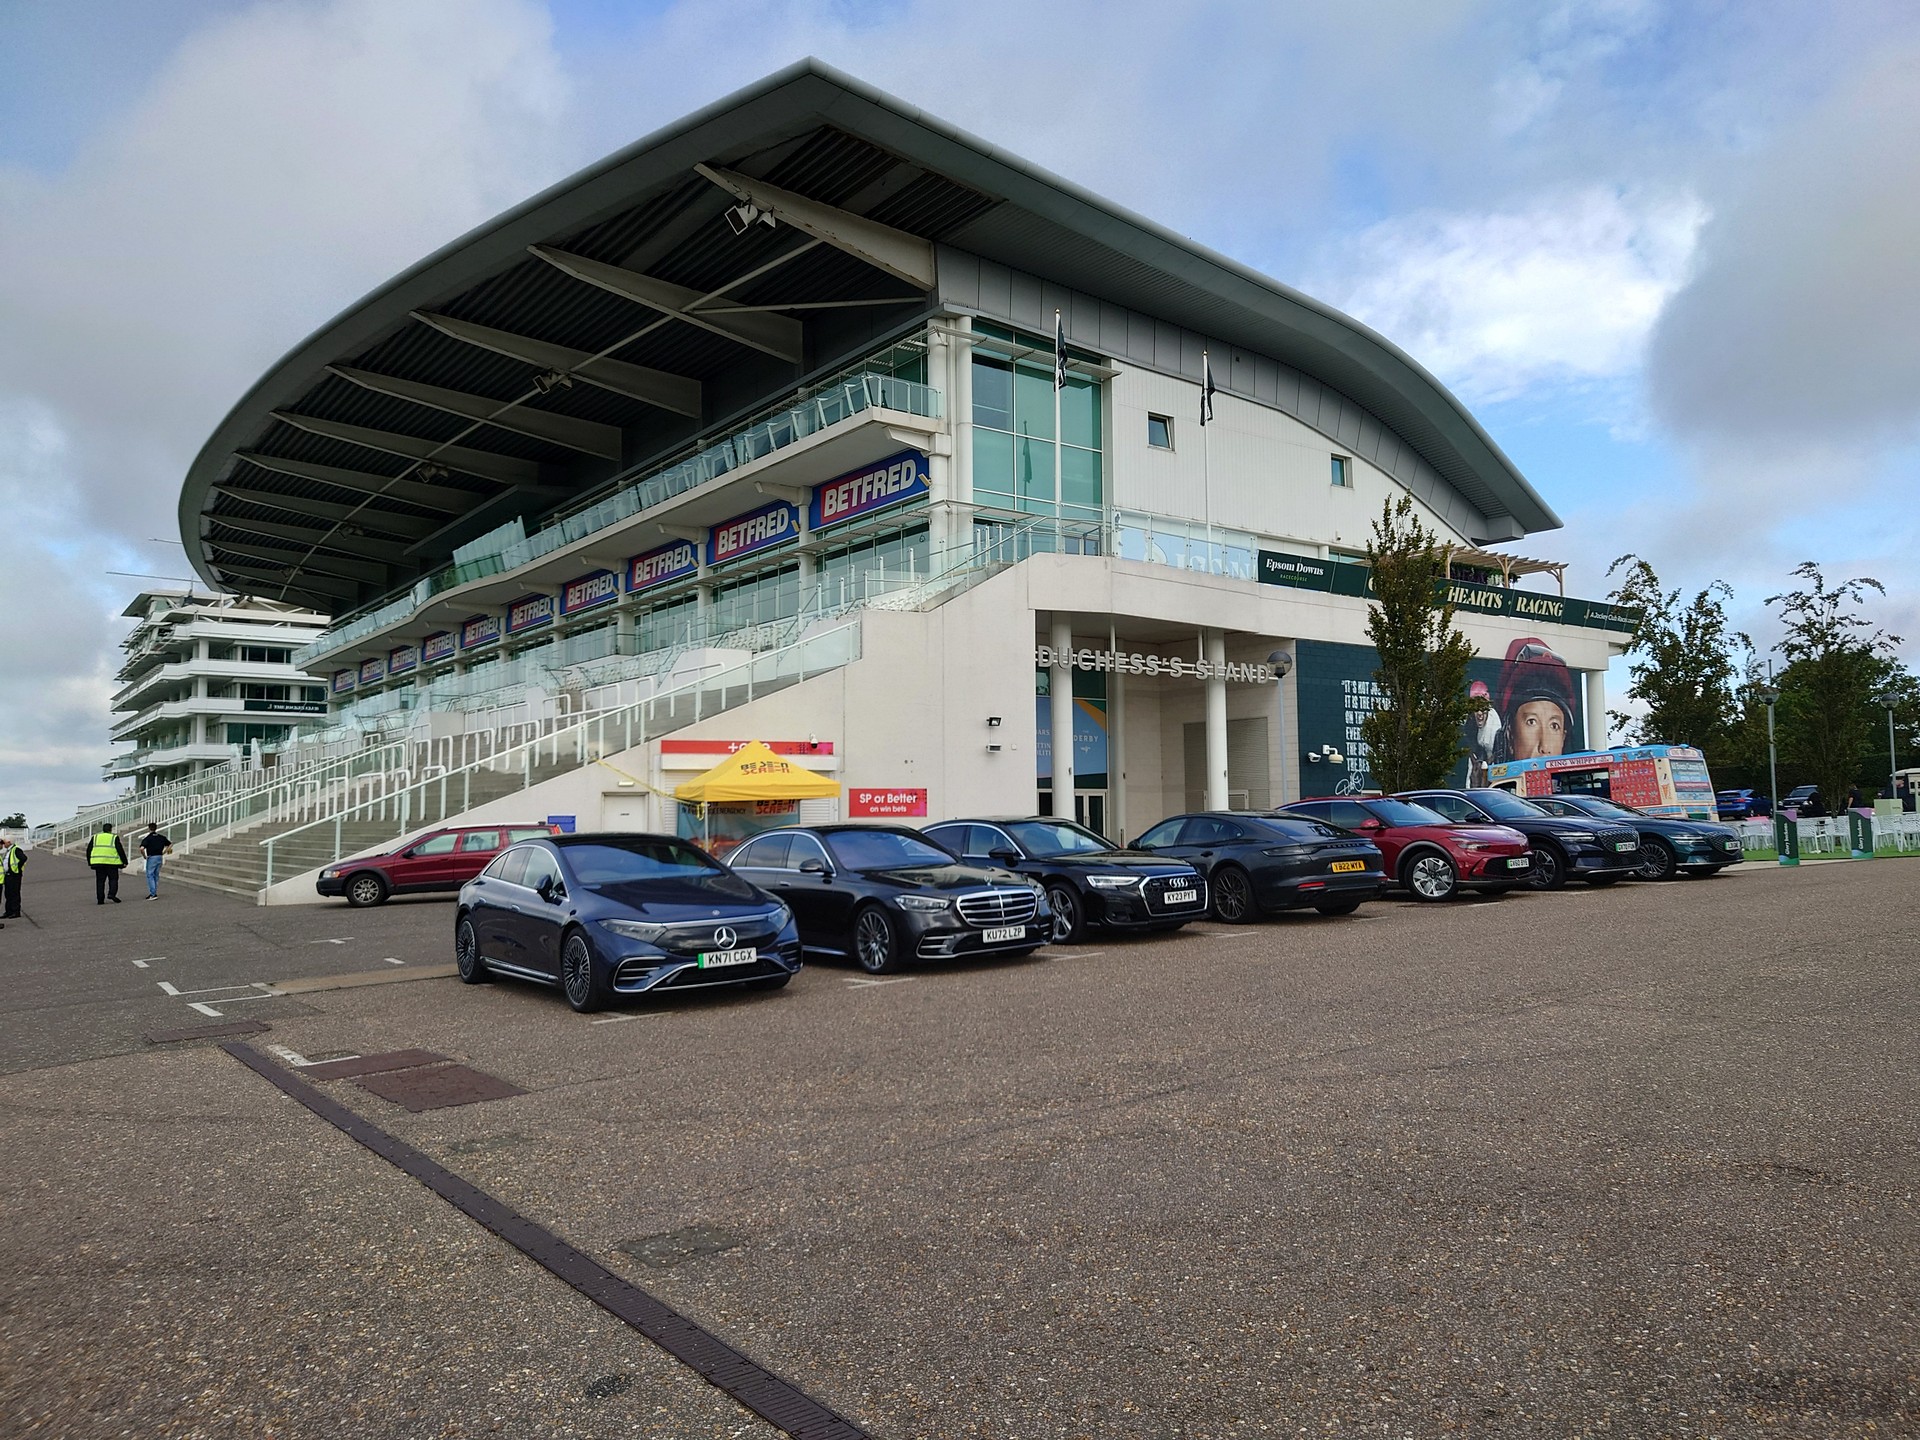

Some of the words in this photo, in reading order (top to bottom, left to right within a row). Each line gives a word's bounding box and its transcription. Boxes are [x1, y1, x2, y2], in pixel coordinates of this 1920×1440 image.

[824, 459, 917, 517] BETFRED
[717, 507, 789, 555] BETFRED
[634, 544, 691, 584] BETFRED
[1266, 558, 1295, 572] Epsom
[1296, 562, 1324, 576] Downs
[1280, 574, 1308, 582] RACECOURSE
[567, 572, 614, 607] BETFRED
[1447, 586, 1503, 609] HEARTS
[1515, 596, 1563, 617] RACING
[512, 597, 551, 624] BETFRED
[465, 618, 498, 643] BETFRED
[1037, 645, 1182, 678] DUCHESS'S
[1196, 659, 1270, 684] STAND
[1358, 681, 1369, 695] NOT
[1344, 695, 1351, 709] IT
[1352, 695, 1358, 709] IS
[1360, 696, 1370, 709] THE
[1074, 734, 1099, 743] DERBY
[1346, 742, 1357, 756] THE
[1346, 758, 1358, 771] THE
[1550, 760, 1568, 768] KING
[1569, 758, 1597, 766] WHIPPY
[859, 794, 872, 804] SP
[874, 796, 885, 804] or
[887, 794, 918, 804] Better
[1167, 892, 1182, 902] KY23
[1184, 891, 1194, 900] PYT
[987, 929, 1007, 940] KU72
[1009, 927, 1022, 937] LZP
[708, 953, 731, 964] KN71
[734, 950, 752, 962] CGX
